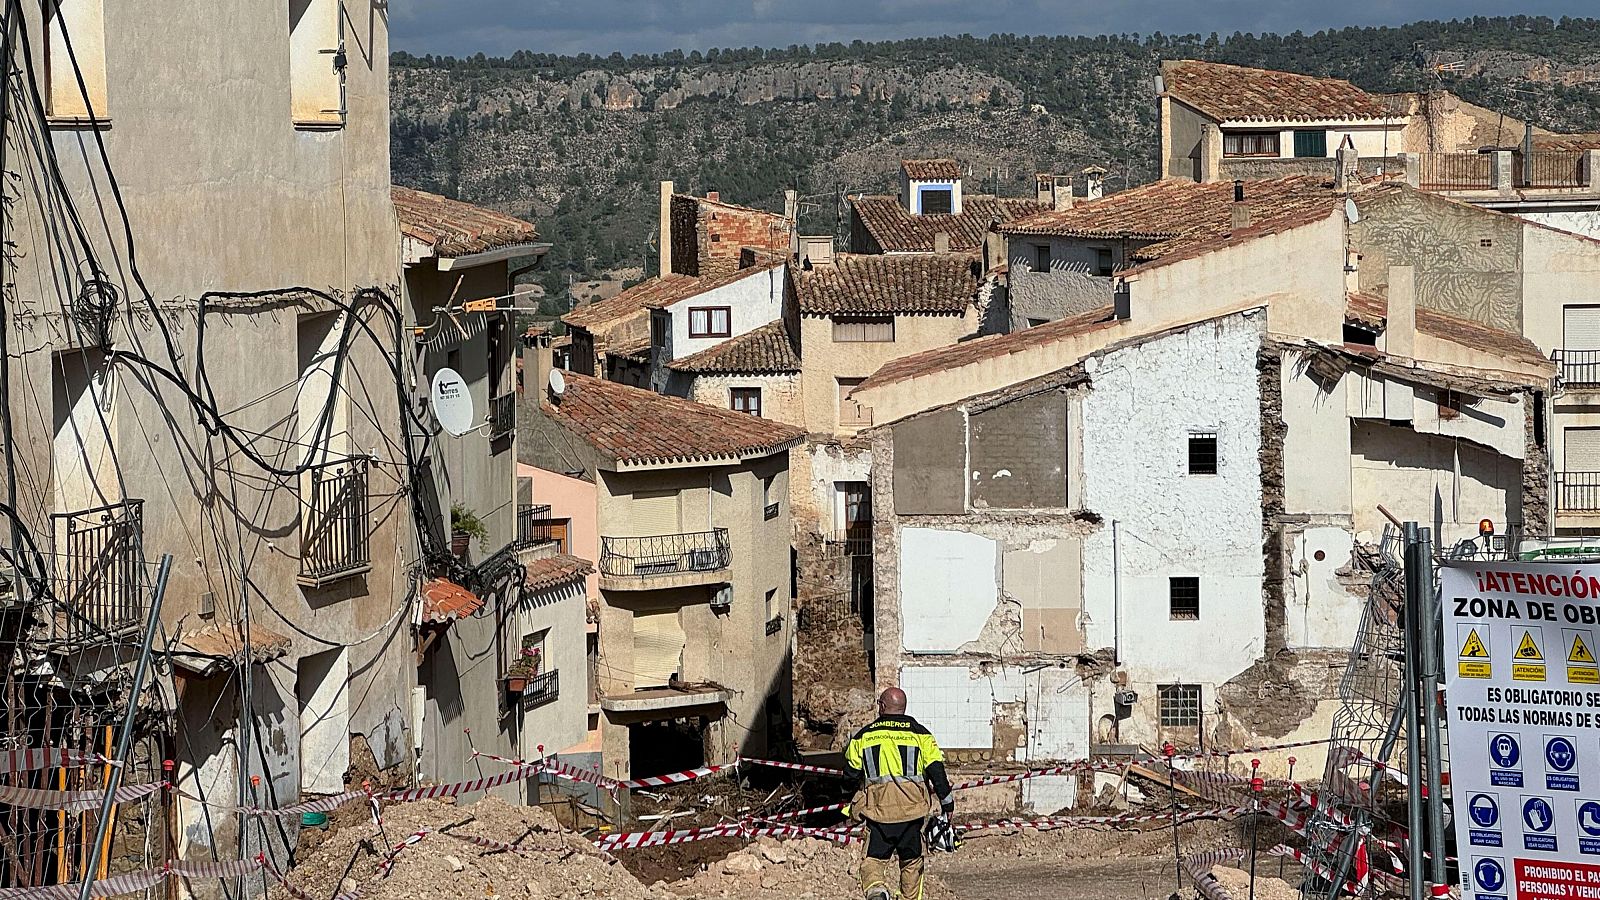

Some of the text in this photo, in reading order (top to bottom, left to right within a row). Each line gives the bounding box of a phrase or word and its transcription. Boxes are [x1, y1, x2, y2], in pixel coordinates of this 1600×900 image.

[1454, 598, 1521, 619] ZONA
[1526, 602, 1557, 621] DE
[1488, 688, 1600, 707] ES OBLIGATORIO SE
[1458, 707, 1495, 722] TODAS
[1498, 709, 1519, 724] LAS
[1524, 710, 1572, 728] NORMAS
[1576, 713, 1591, 728] DE
[1524, 866, 1600, 883] PROHIBIDO EL PA
[1520, 881, 1566, 896] PERSONAS
[1568, 885, 1574, 896] Y
